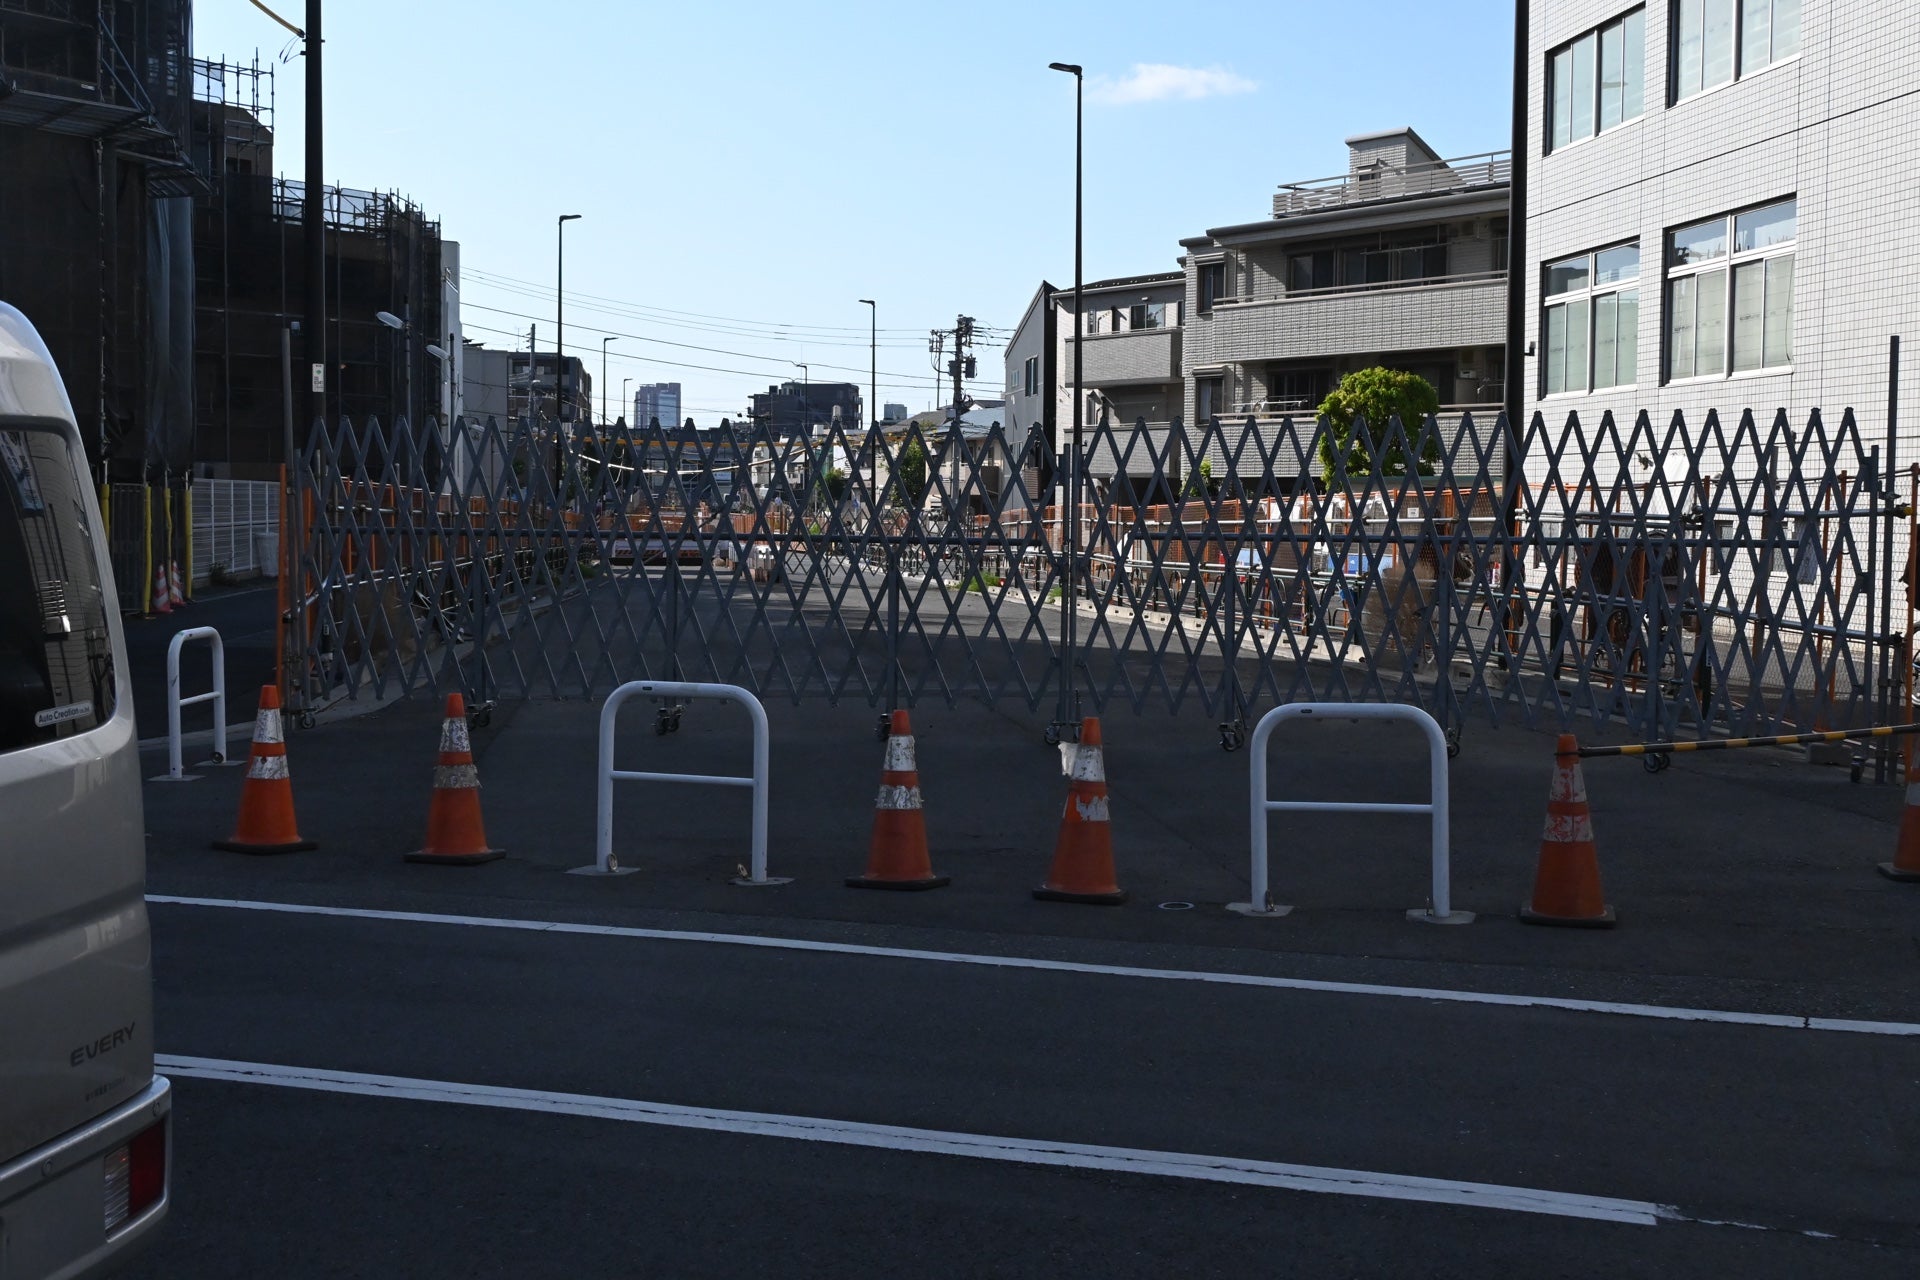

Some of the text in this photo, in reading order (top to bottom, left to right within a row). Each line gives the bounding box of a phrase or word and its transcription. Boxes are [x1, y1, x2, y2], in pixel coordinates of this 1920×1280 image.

[38, 713, 53, 723] Auto
[54, 707, 79, 720] Creation
[70, 1021, 136, 1067] EVERY
